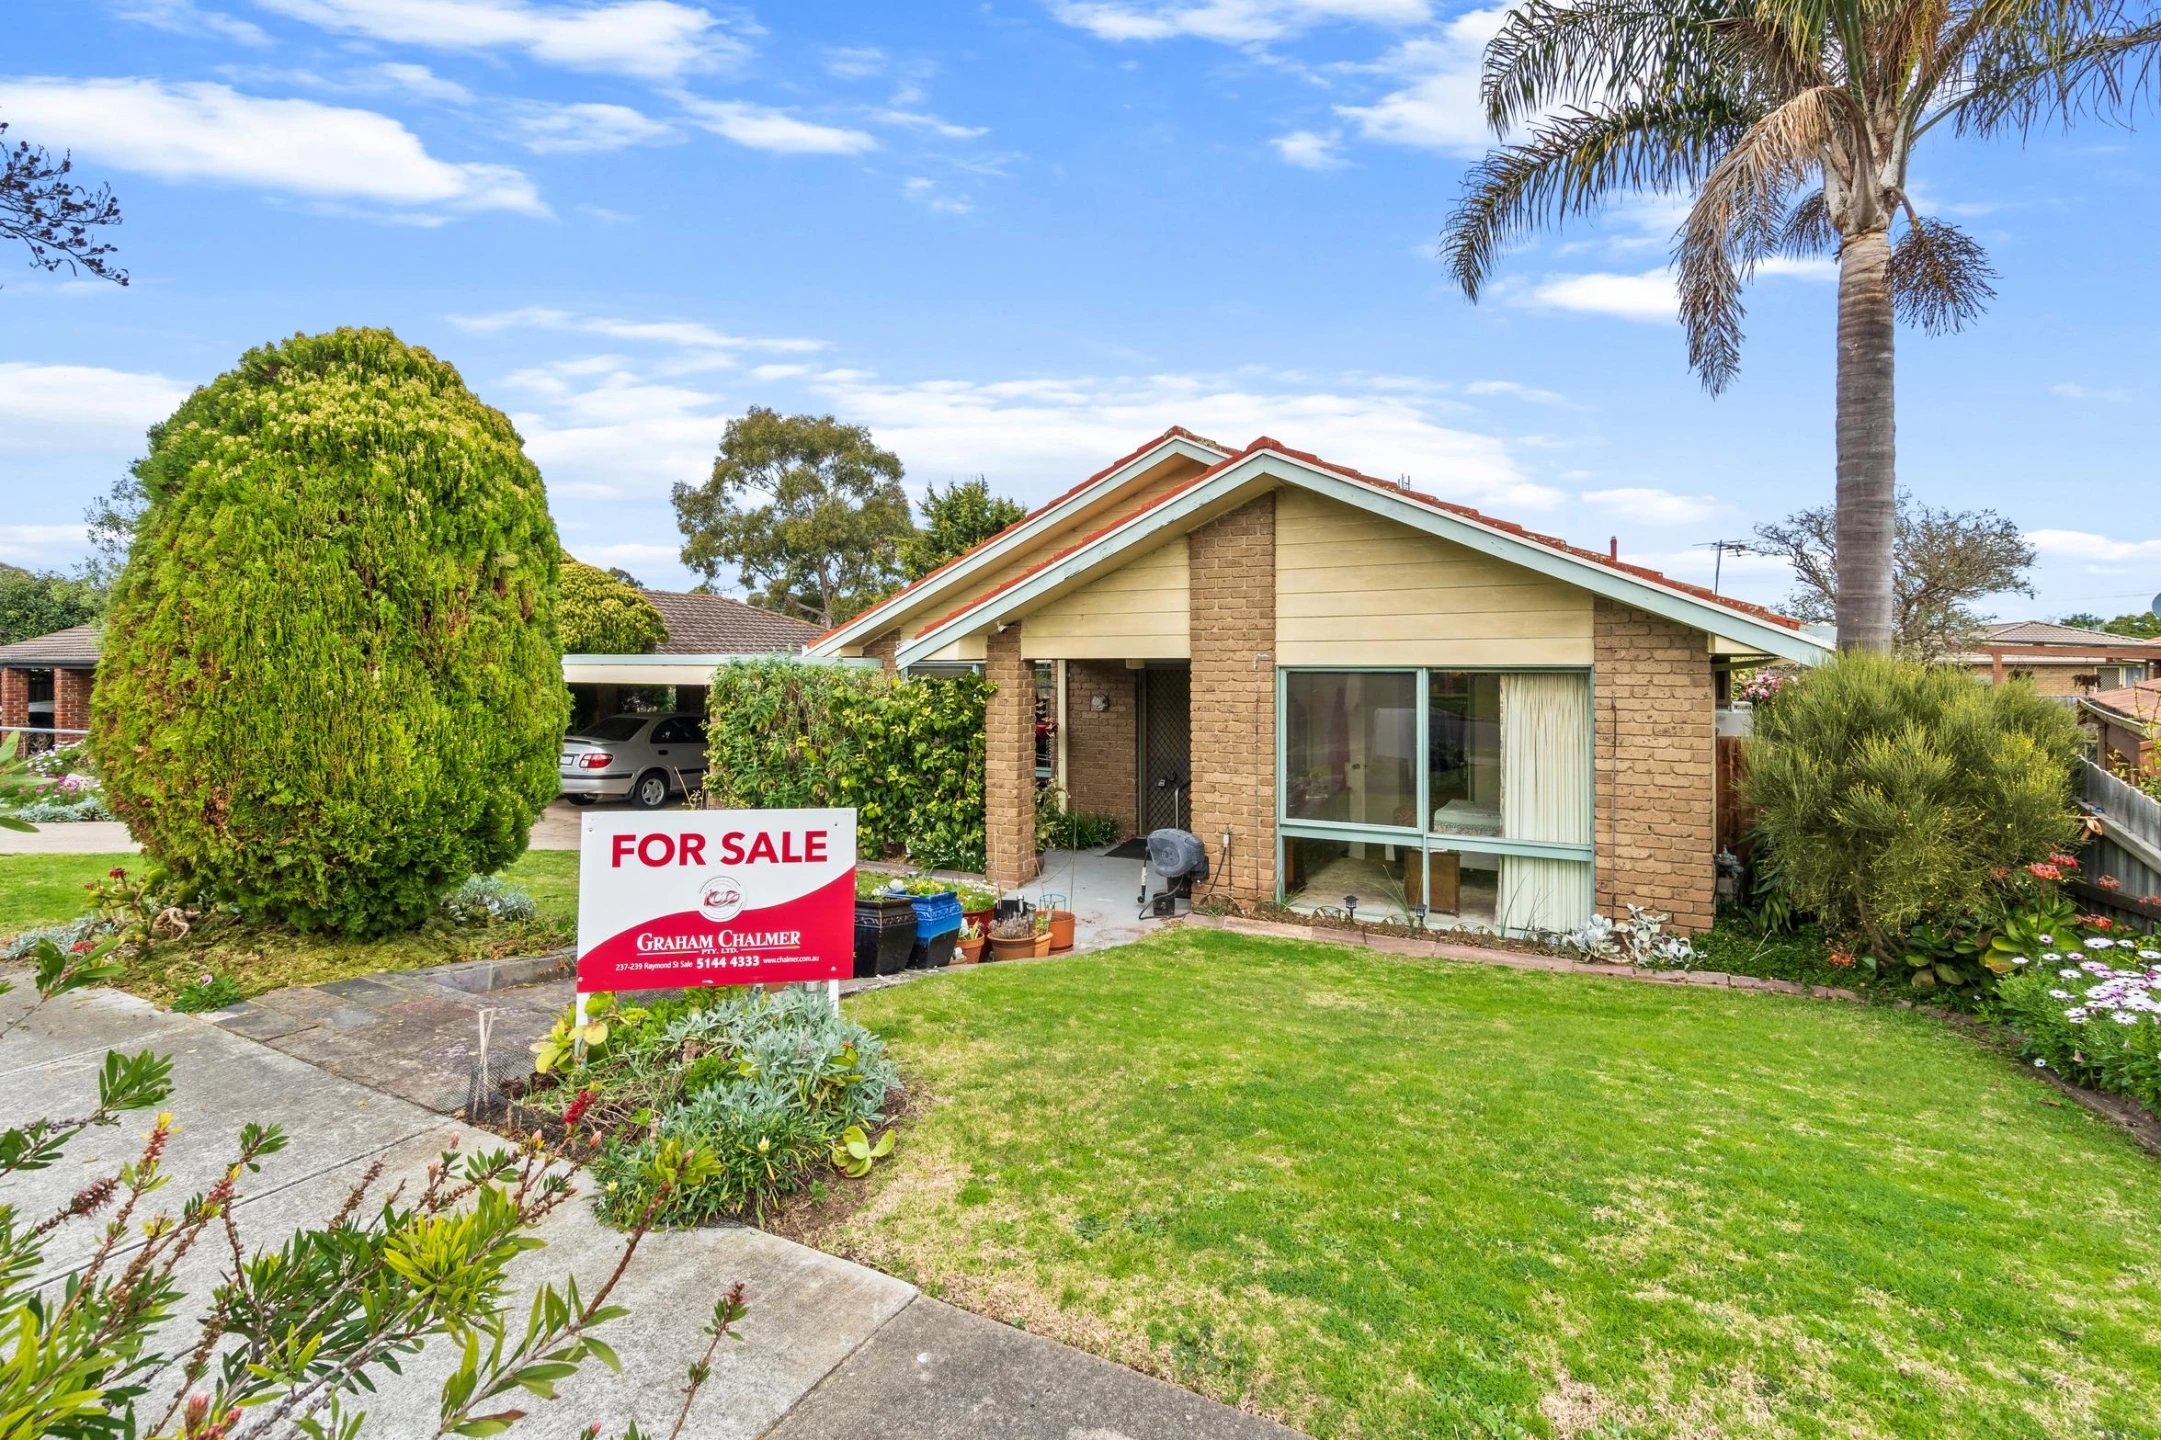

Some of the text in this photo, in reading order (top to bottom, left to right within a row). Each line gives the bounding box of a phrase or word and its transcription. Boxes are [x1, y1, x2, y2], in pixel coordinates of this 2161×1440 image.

[612, 831, 828, 868] FOR SALE
[636, 929, 801, 951] GRAHAM CHALMER
[615, 955, 820, 971] 237-239 Raymond St Sale 5144 4333 www.chalmer.com.au
